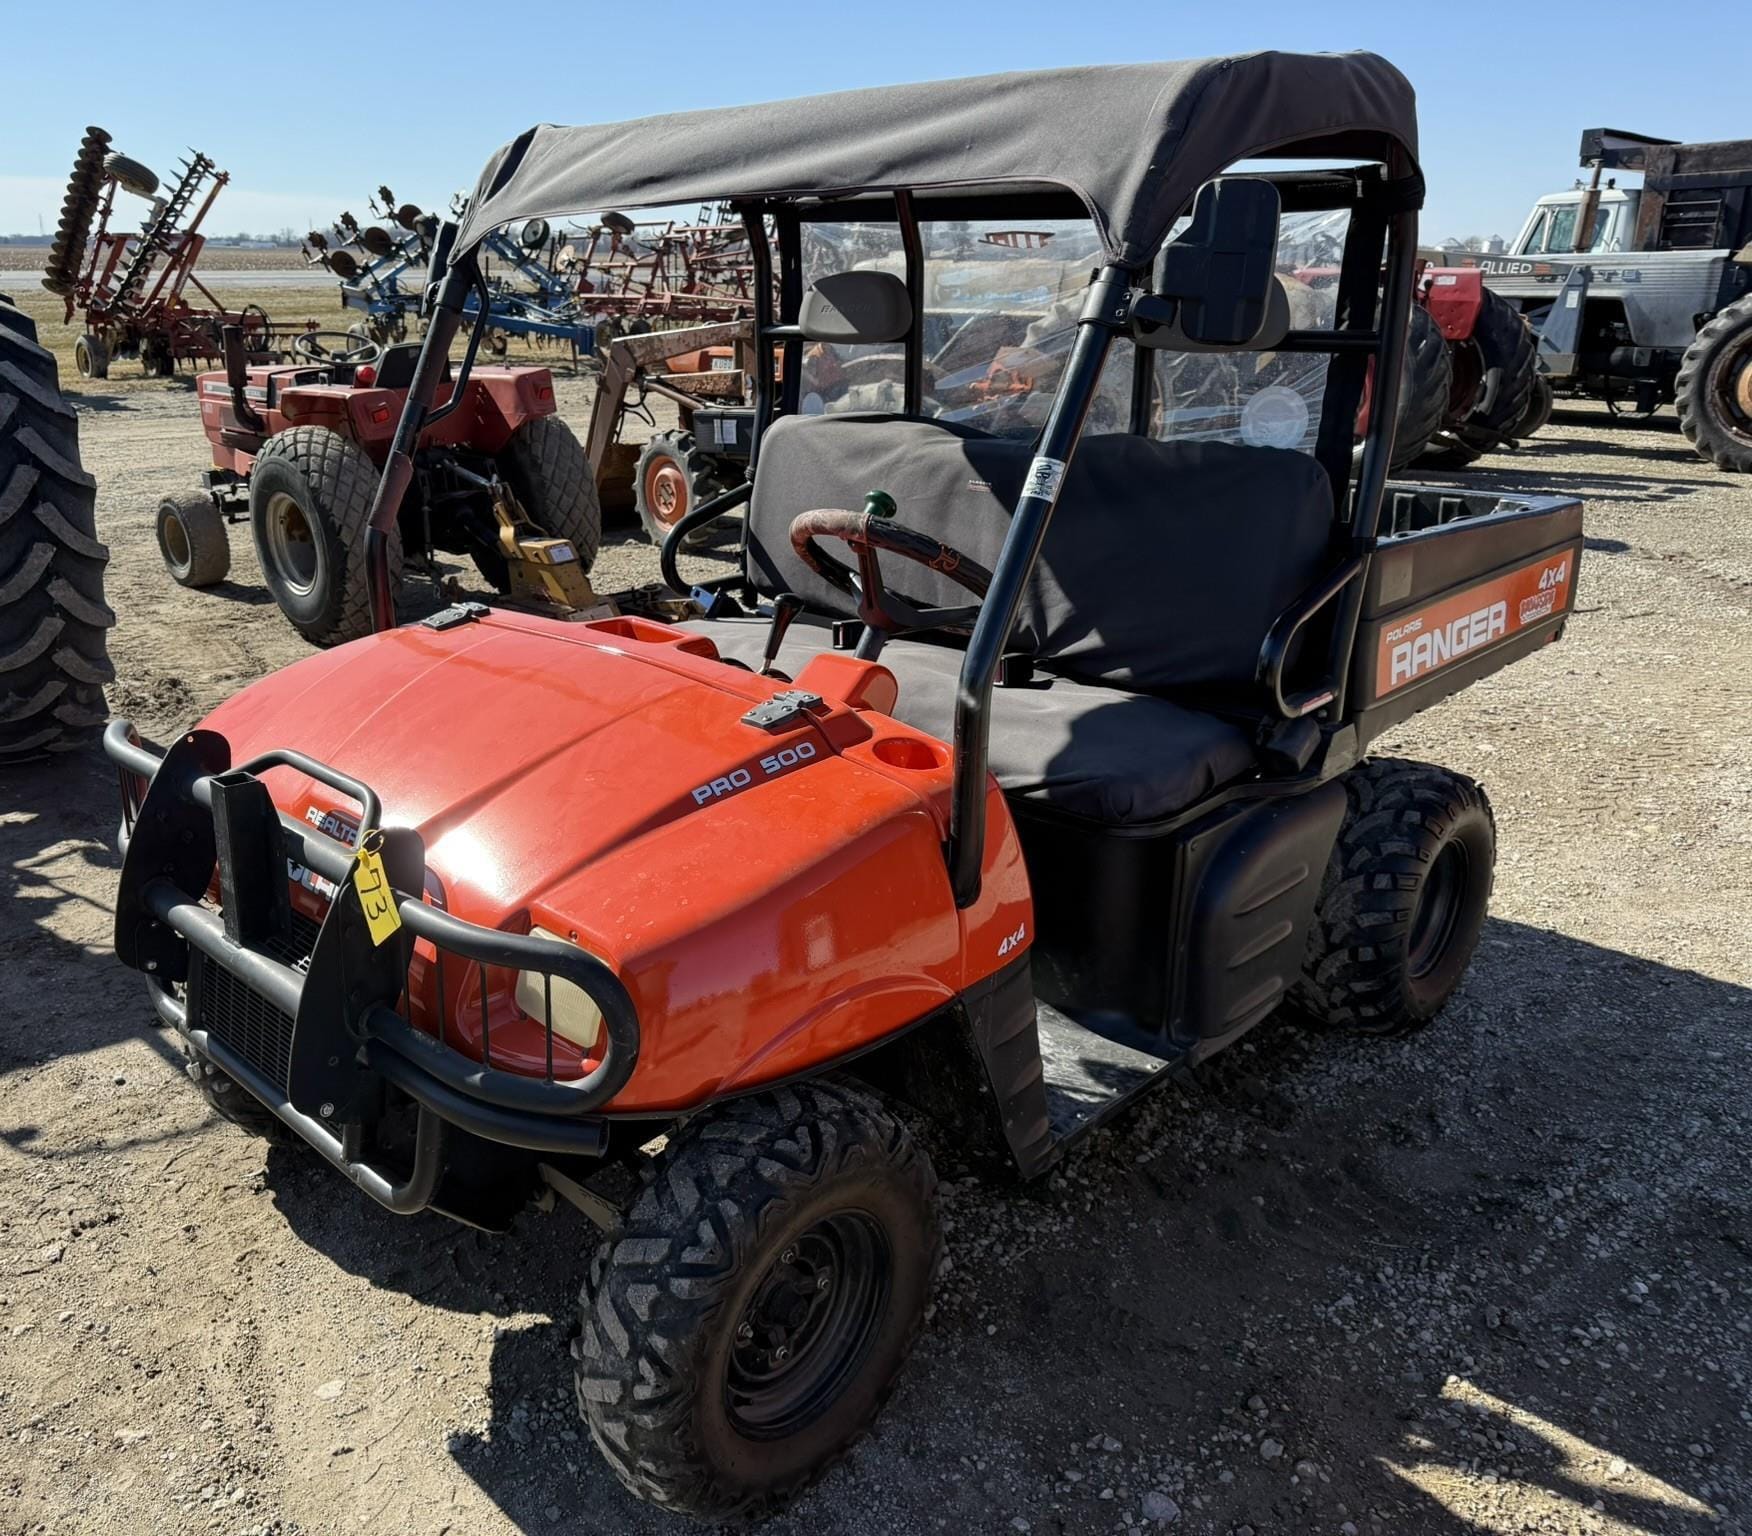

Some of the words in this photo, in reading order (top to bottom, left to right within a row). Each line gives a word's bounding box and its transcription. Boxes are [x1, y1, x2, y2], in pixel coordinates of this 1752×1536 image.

[1480, 260, 1532, 274] ALLIED
[713, 358, 733, 370] KUBO
[1386, 617, 1423, 644] POLARIS
[1391, 600, 1508, 686] RANGER
[691, 768, 752, 805] PRO
[759, 741, 816, 775] 500
